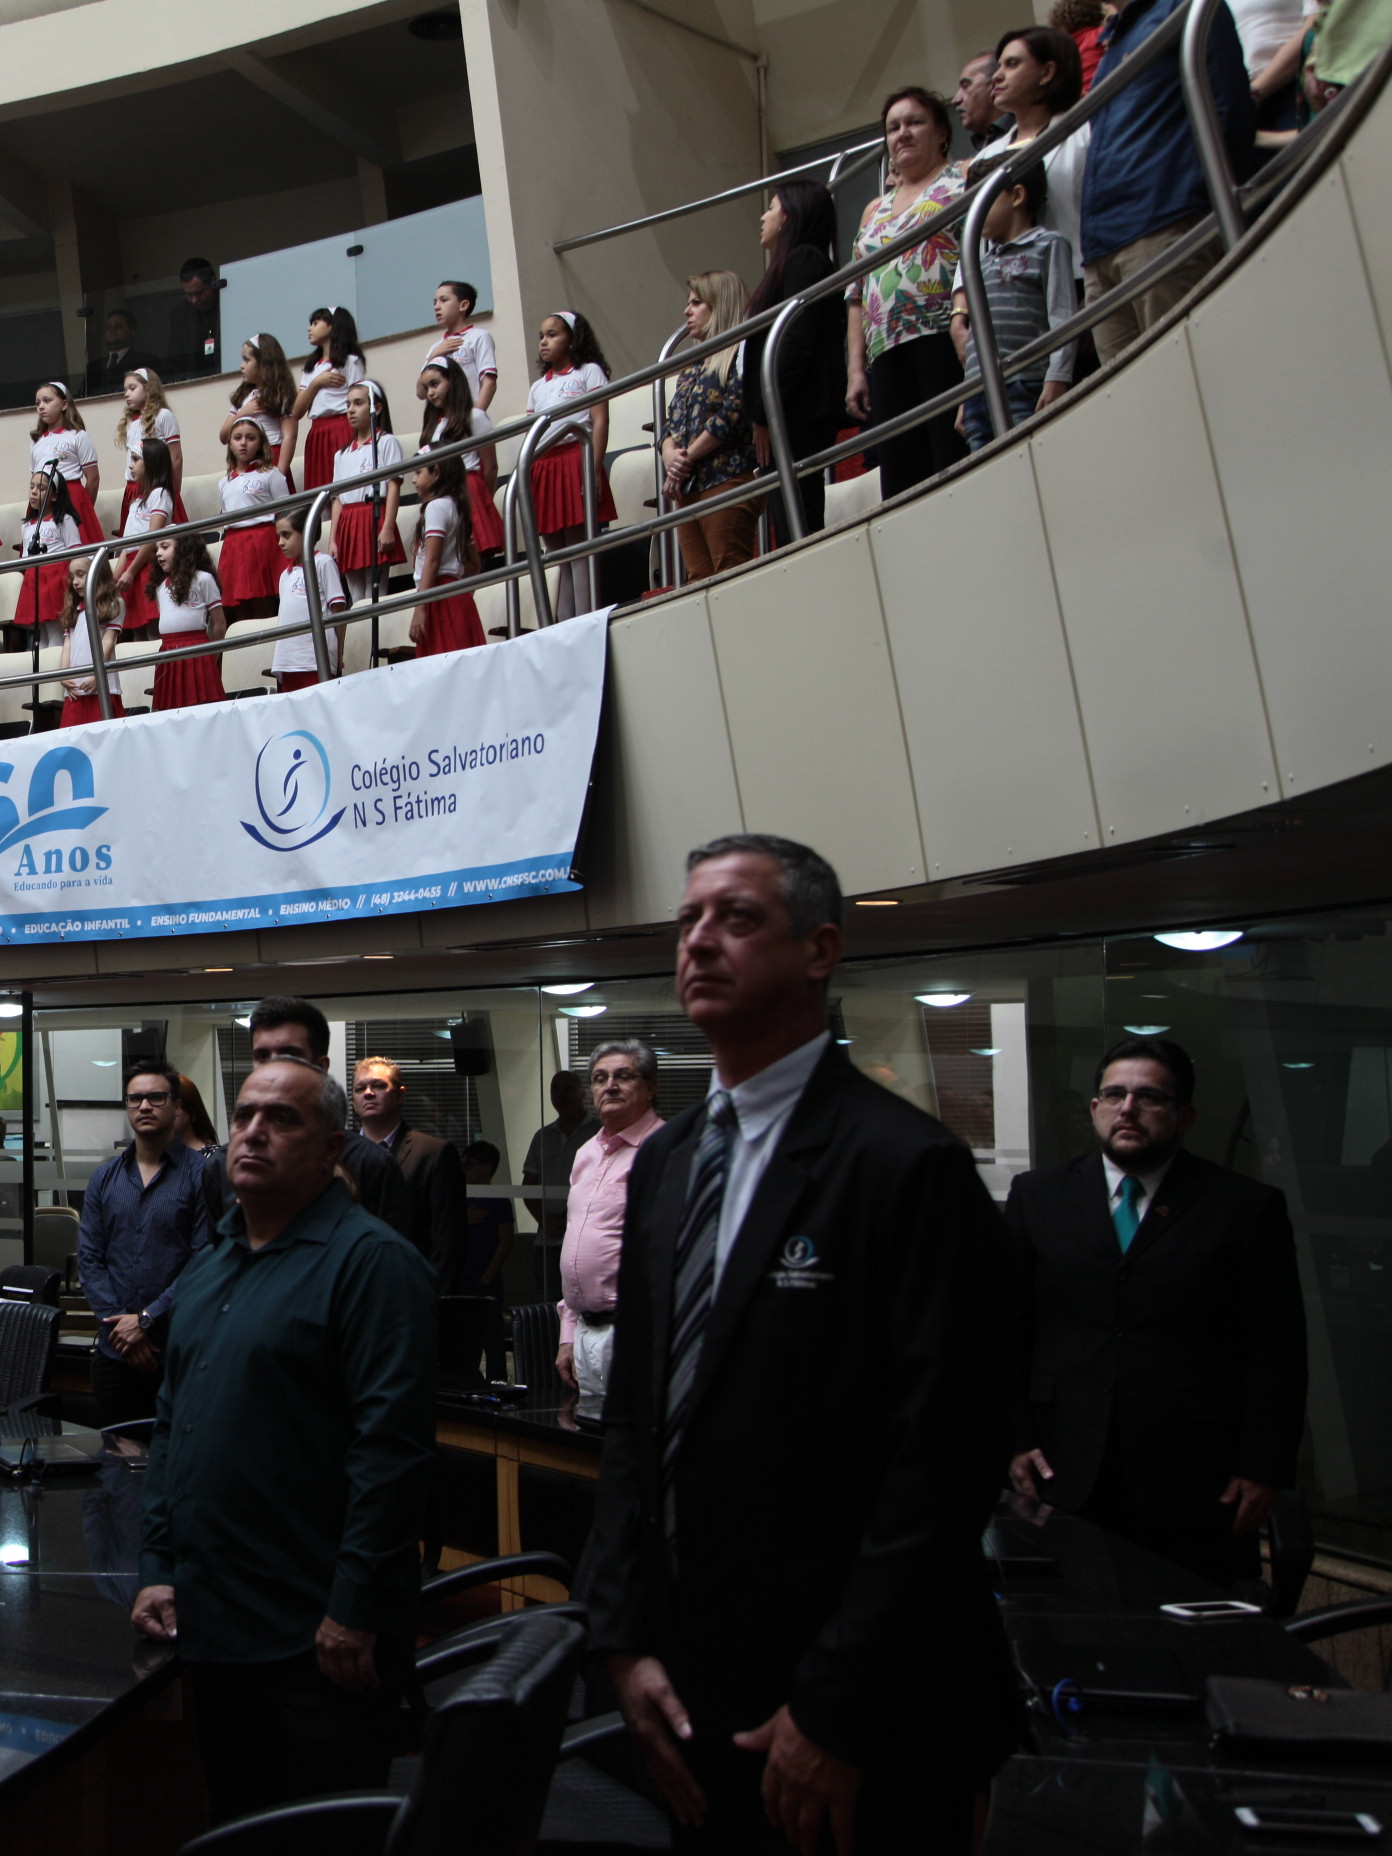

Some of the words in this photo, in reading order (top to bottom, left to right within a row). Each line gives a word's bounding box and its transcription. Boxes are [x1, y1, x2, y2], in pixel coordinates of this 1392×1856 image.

[351, 755, 420, 792] Colégio
[428, 733, 545, 777] Salvatoriano
[353, 801, 367, 829] N
[374, 798, 386, 826] S
[393, 790, 457, 823] Fátima
[14, 843, 113, 877] Anos
[14, 880, 58, 892] Educando
[60, 878, 82, 891] para
[85, 878, 91, 887] a
[93, 876, 113, 887] vida
[24, 919, 82, 935] EDUCAÇÃO
[84, 917, 131, 932] INFANTIL
[150, 914, 187, 927] ENSINO
[188, 907, 261, 924] FUNDAMENTAL
[279, 901, 316, 916] ENSINO
[318, 896, 351, 912] MÉDIO
[370, 891, 391, 908] (48)
[392, 885, 441, 904] 3244-0455
